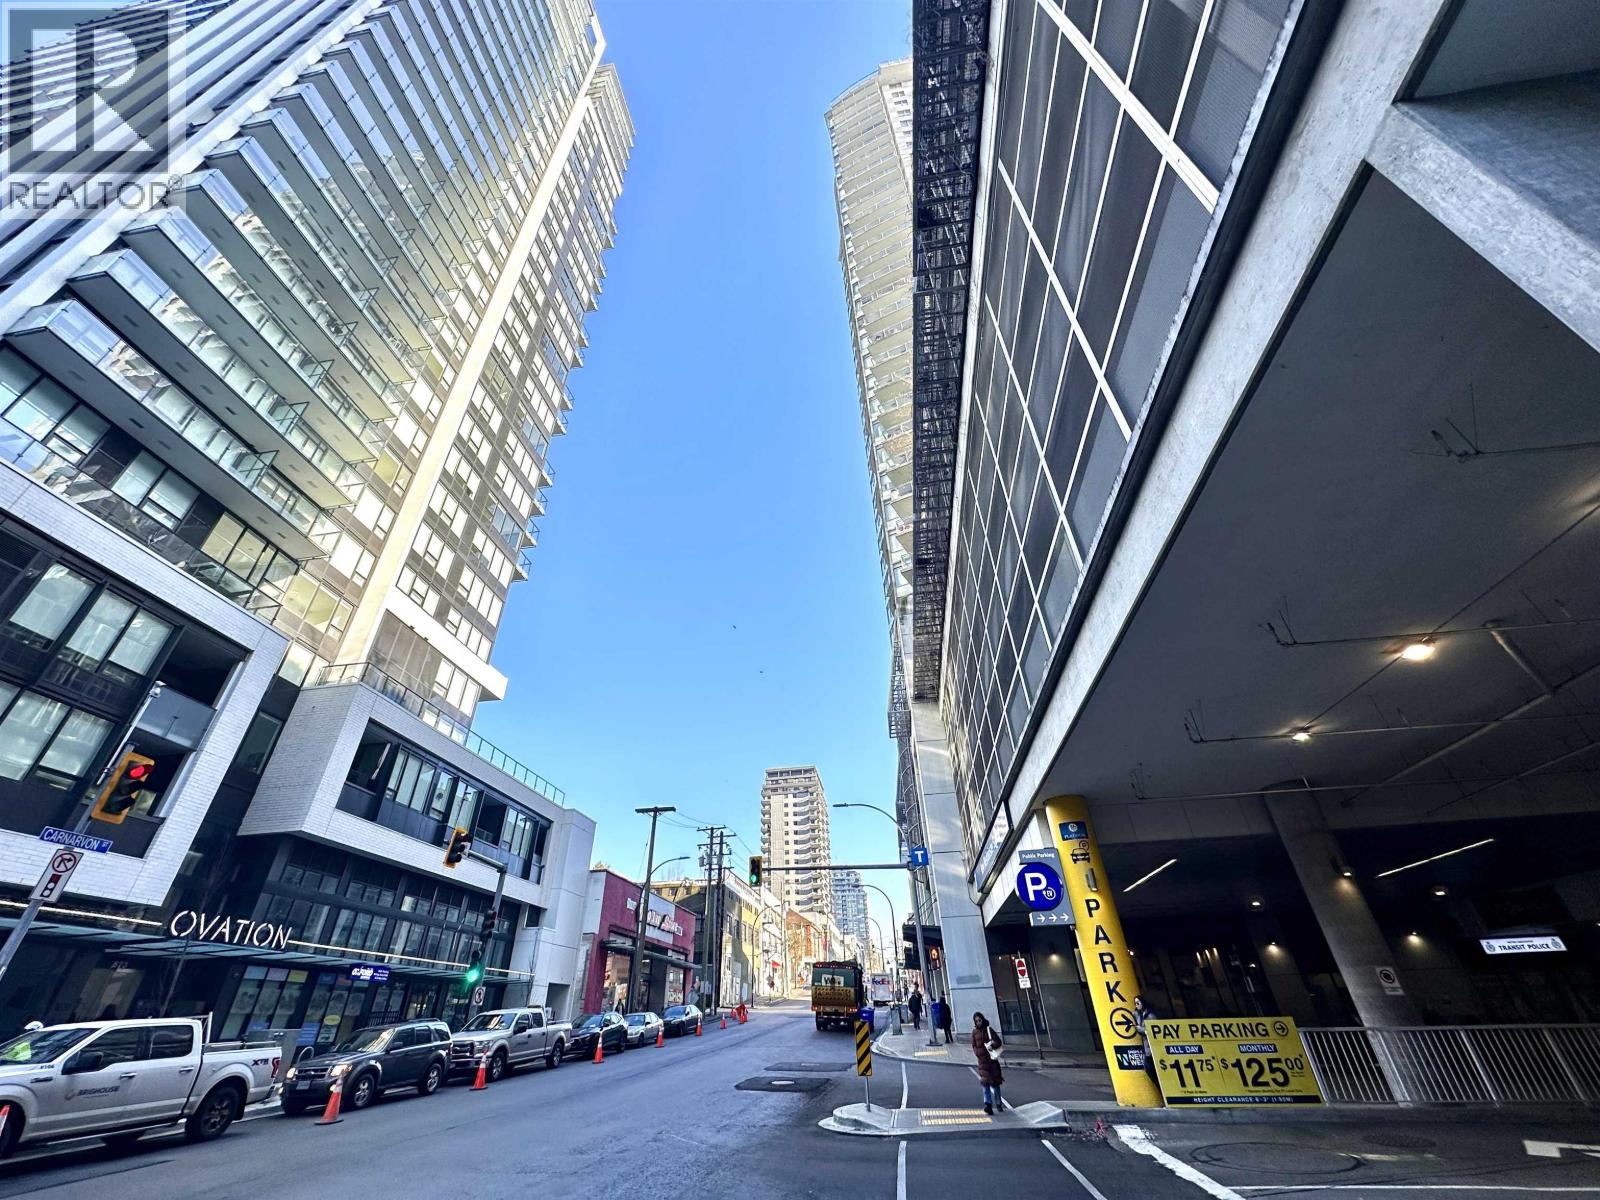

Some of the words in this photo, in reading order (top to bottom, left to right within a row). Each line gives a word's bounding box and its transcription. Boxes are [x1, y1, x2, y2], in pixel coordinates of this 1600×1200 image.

[43, 829, 100, 850] CARNARVON
[914, 850, 924, 863] T
[1024, 872, 1047, 901] P
[170, 910, 292, 949] OVATION
[1085, 898, 1127, 1002] PARK
[1150, 1024, 1181, 1040] PAY
[1188, 1022, 1270, 1038] PARKING
[1169, 1046, 1184, 1054] ALL
[1185, 1045, 1200, 1053] DAY
[1239, 1044, 1276, 1053] MONTHLY
